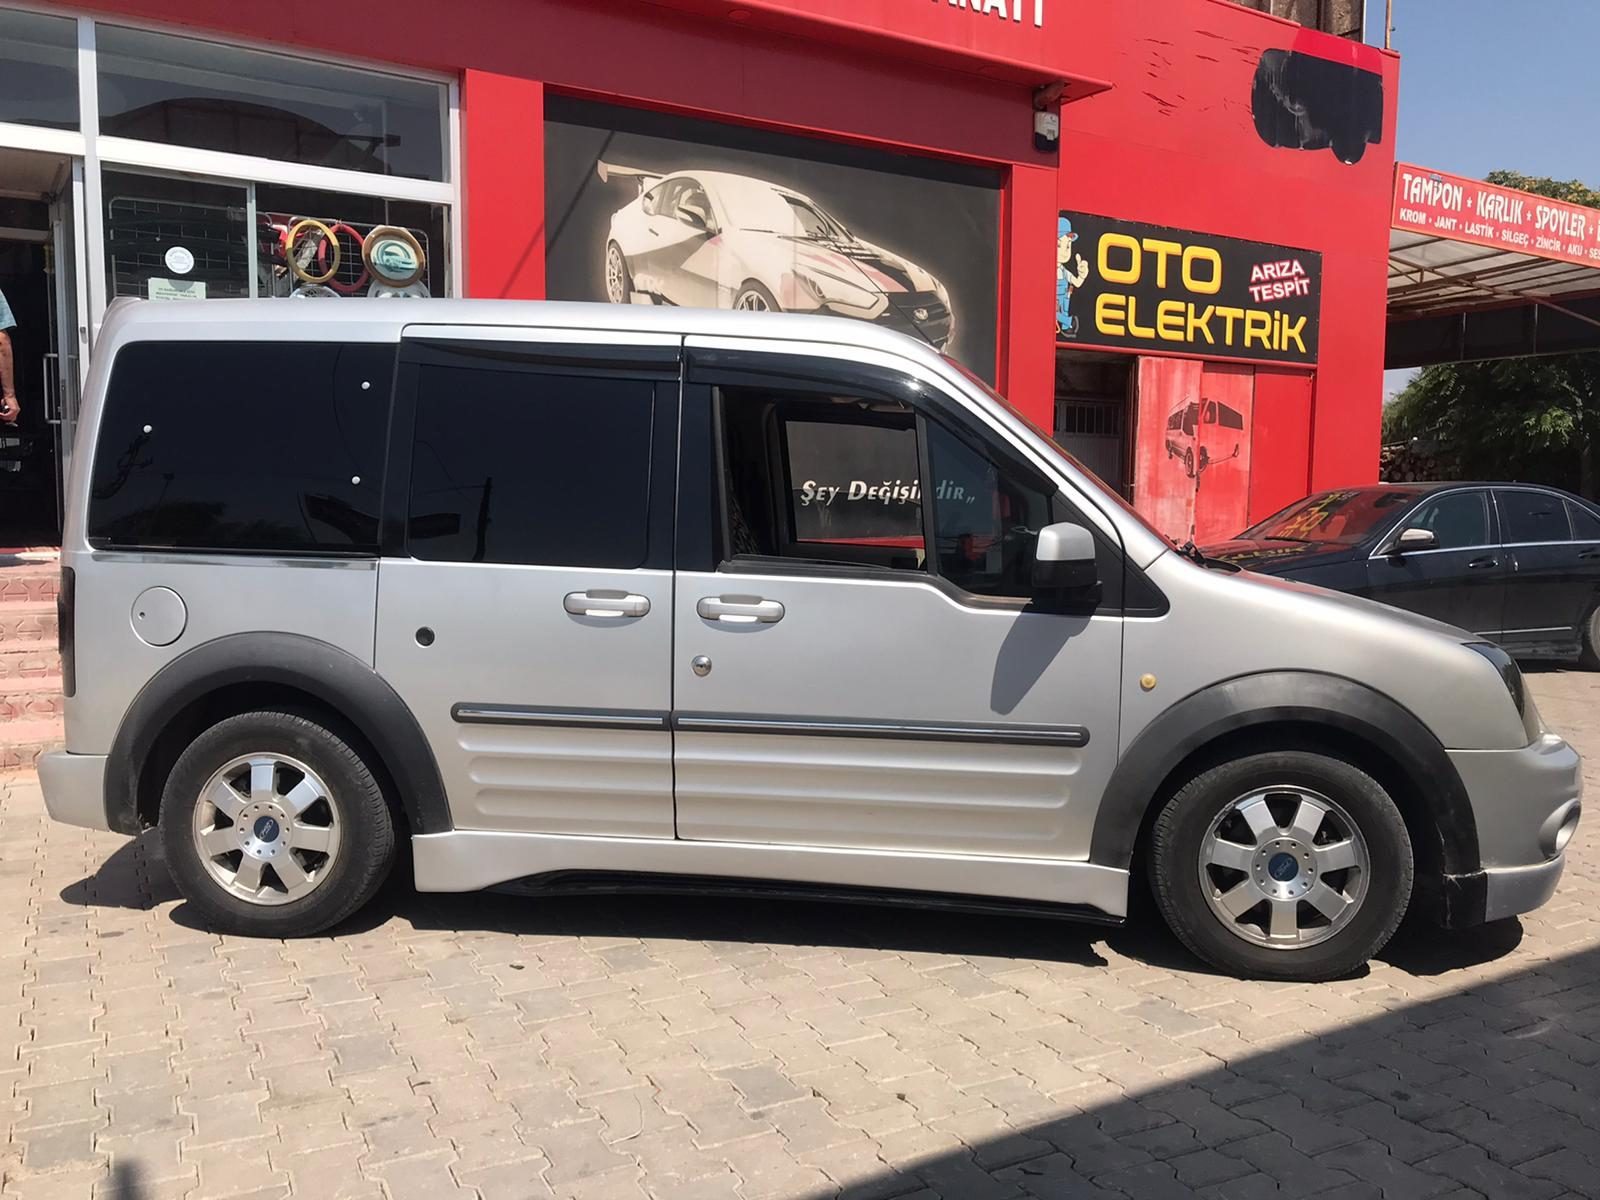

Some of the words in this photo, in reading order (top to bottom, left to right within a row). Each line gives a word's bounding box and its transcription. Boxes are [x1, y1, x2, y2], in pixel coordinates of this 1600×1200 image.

[1402, 173, 1463, 212] TAMPON
[1476, 191, 1524, 224] KARLIK
[1535, 205, 1586, 240] SPOYLER
[1400, 208, 1426, 225] KROM
[1434, 216, 1457, 231] JANT
[1465, 221, 1494, 239] LASTİK
[1097, 232, 1222, 294] OTO
[1250, 259, 1305, 283] ARIZA
[1248, 276, 1310, 303] TESPİT
